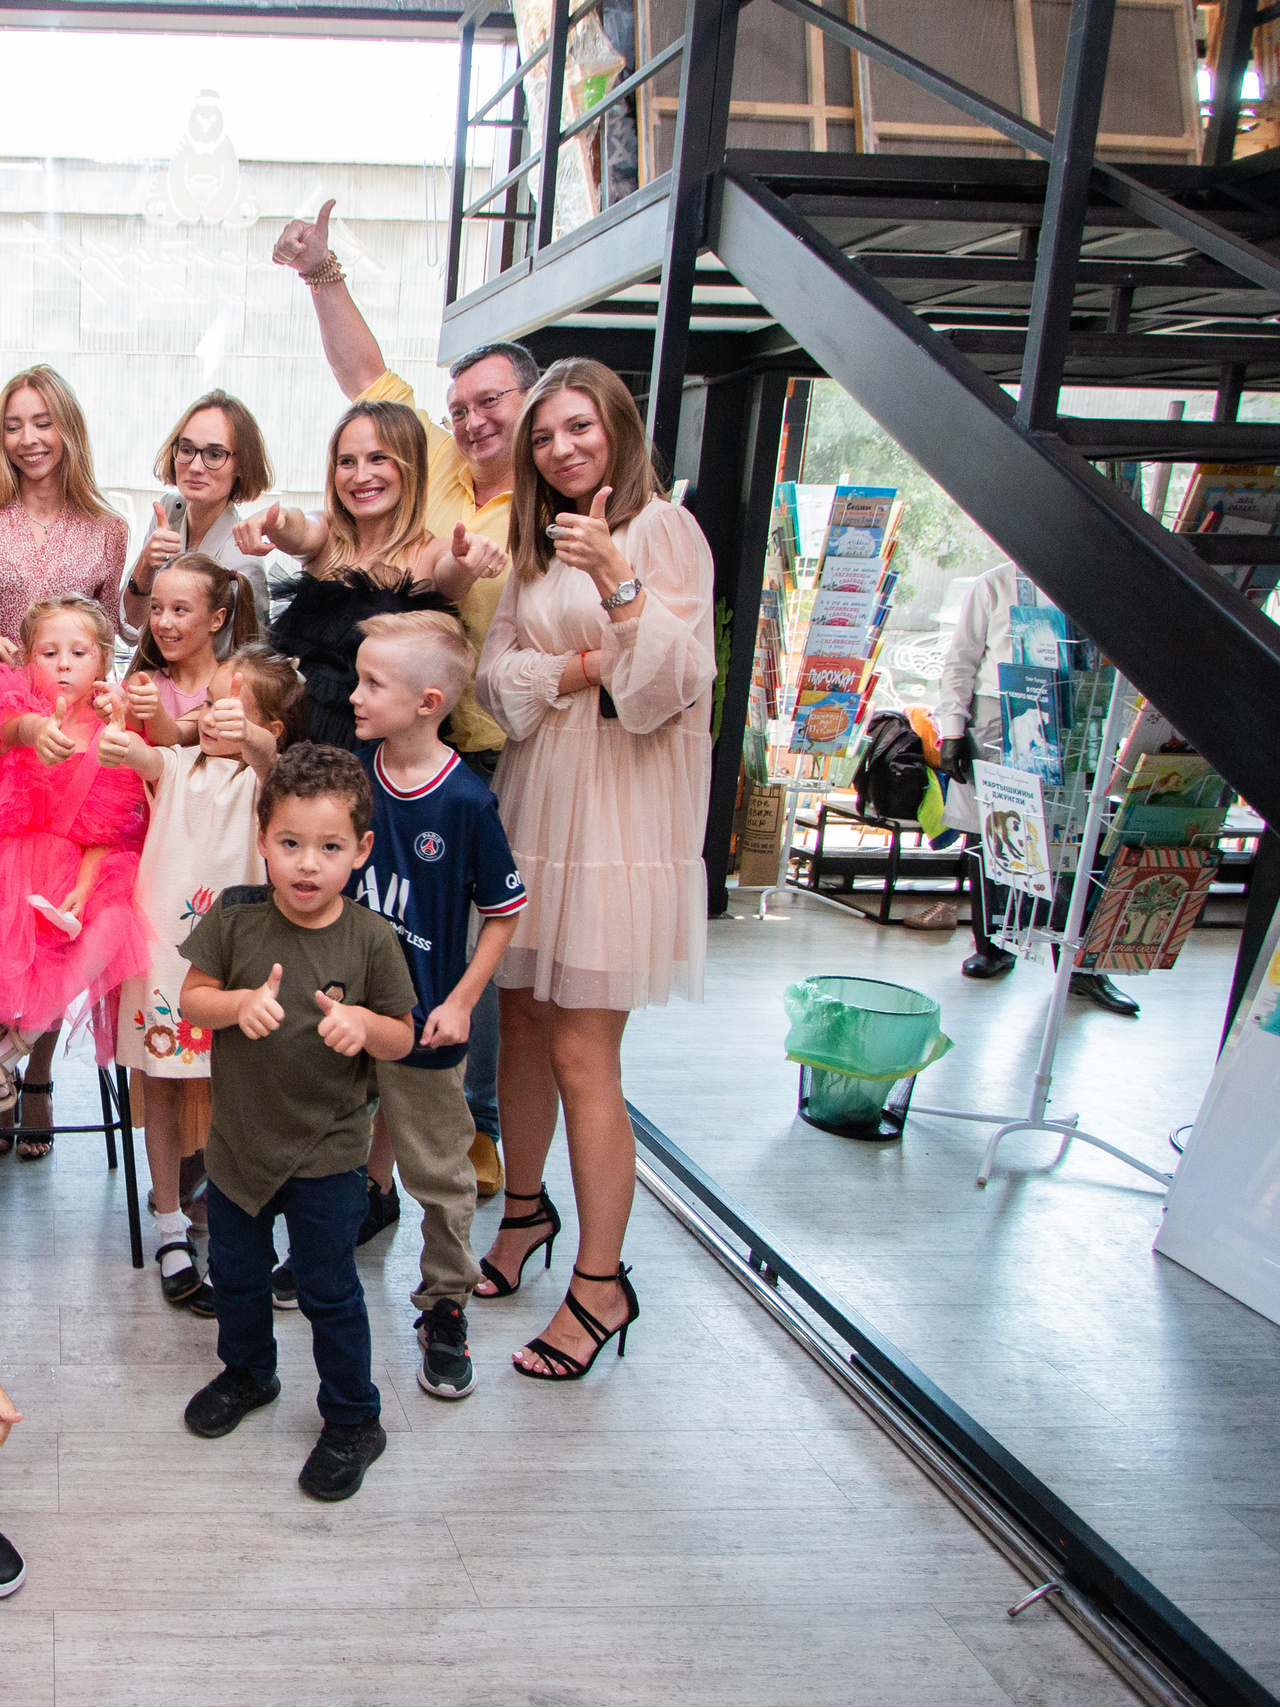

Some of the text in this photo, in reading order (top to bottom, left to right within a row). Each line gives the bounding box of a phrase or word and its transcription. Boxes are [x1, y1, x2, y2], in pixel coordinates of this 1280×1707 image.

[808, 668, 856, 689] ПИРОЖКИ
[982, 779, 1035, 799] МАРТЫШКИНЫ
[992, 790, 1026, 806] ДЖУНГЛИ
[1109, 944, 1135, 953] ЕРЕВО
